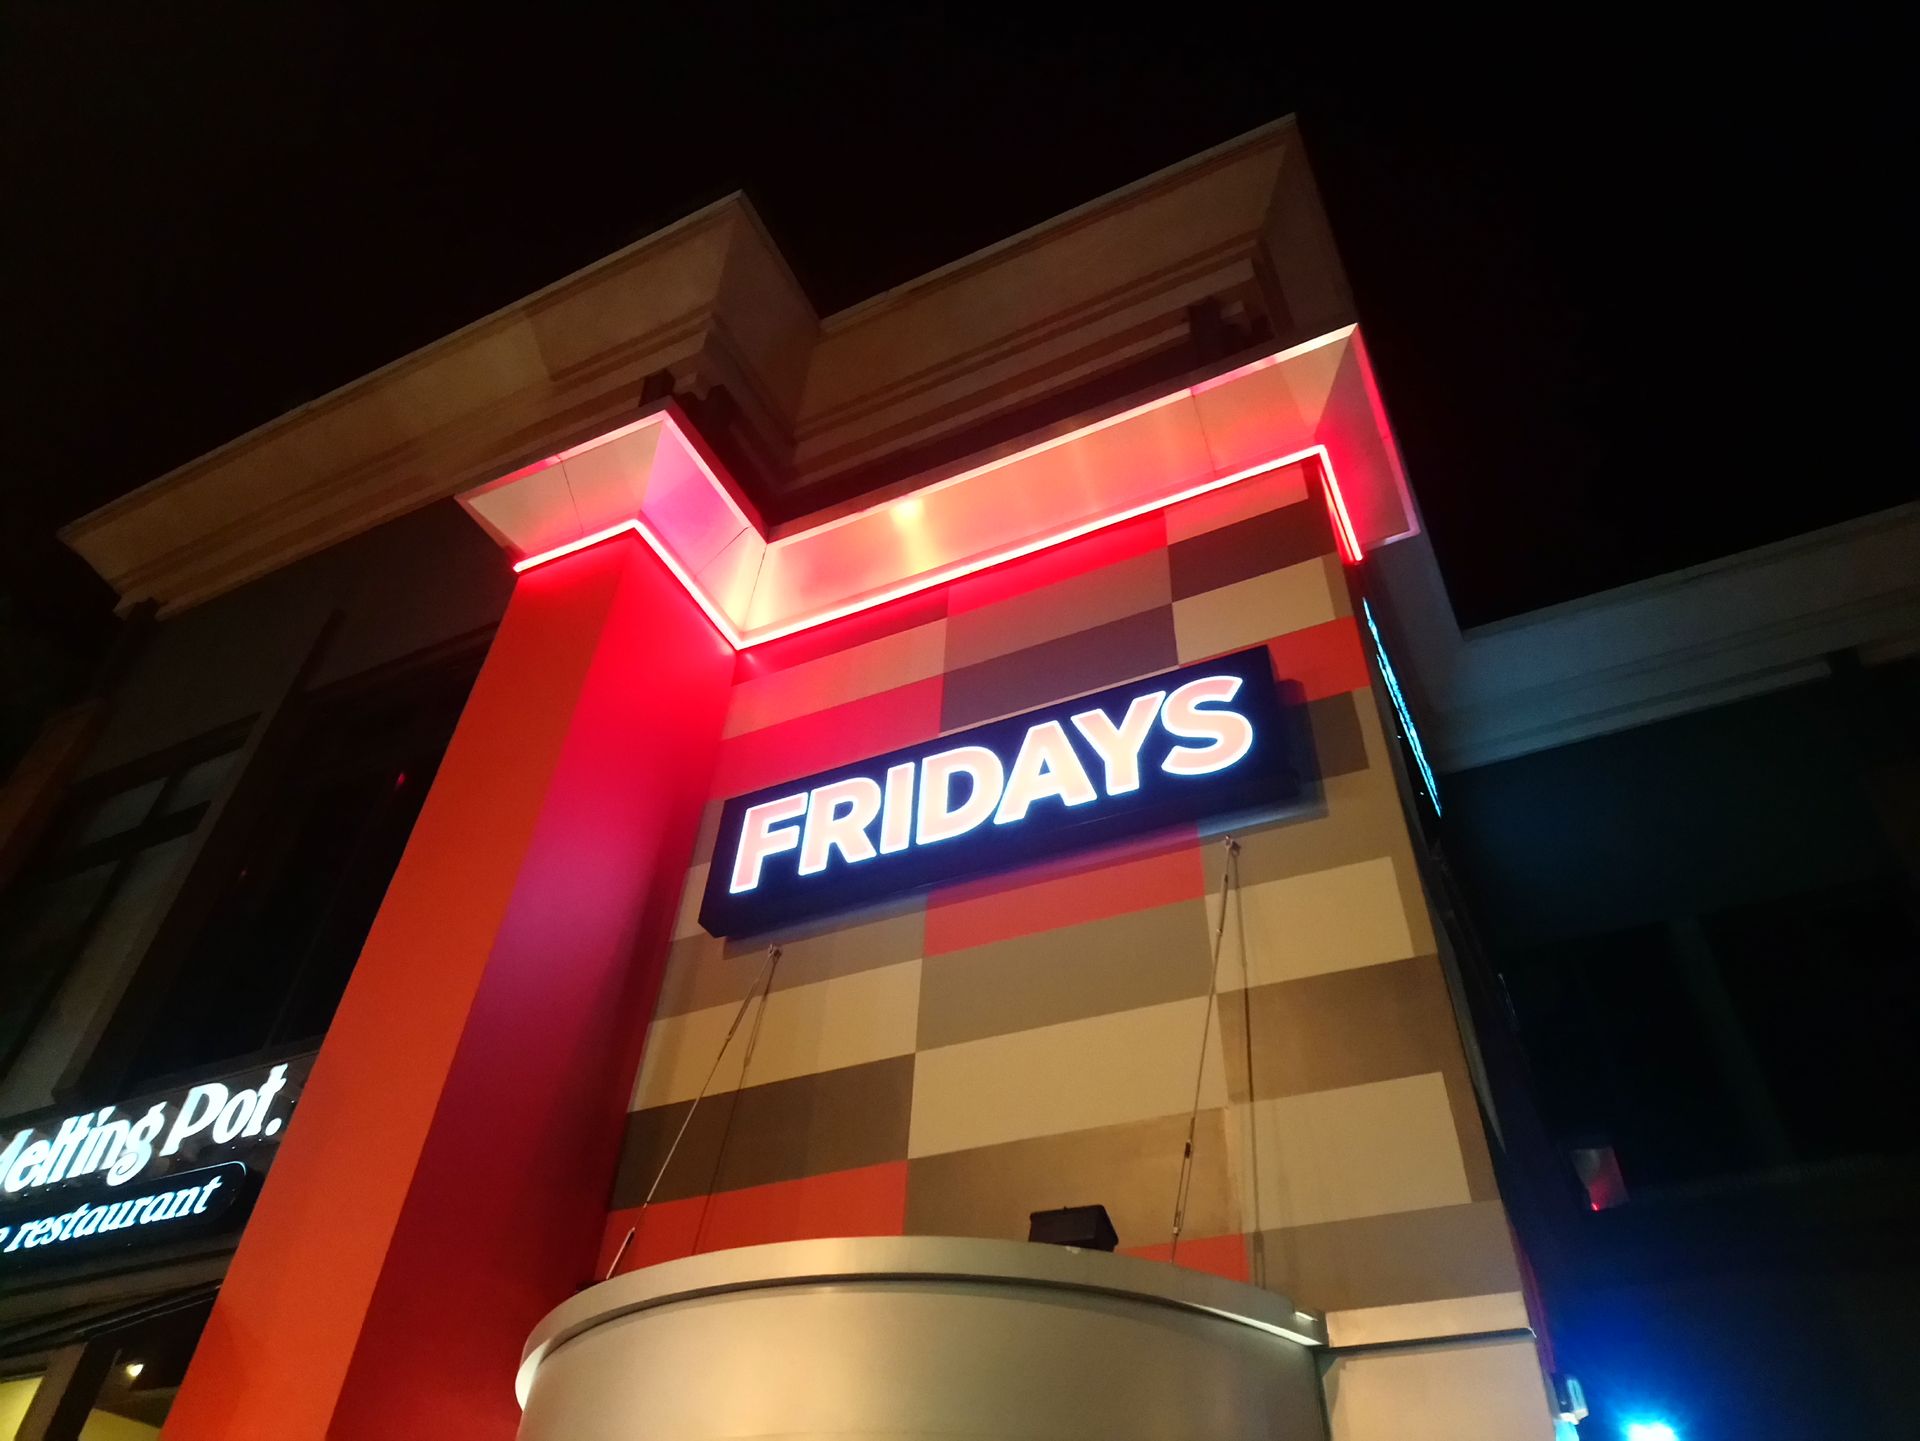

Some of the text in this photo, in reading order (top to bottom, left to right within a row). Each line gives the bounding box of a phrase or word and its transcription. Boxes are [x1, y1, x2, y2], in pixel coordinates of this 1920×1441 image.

[729, 675, 1254, 894] FRIDAYS
[159, 1063, 289, 1157] Pot.
[3, 1176, 224, 1253] restaurant
